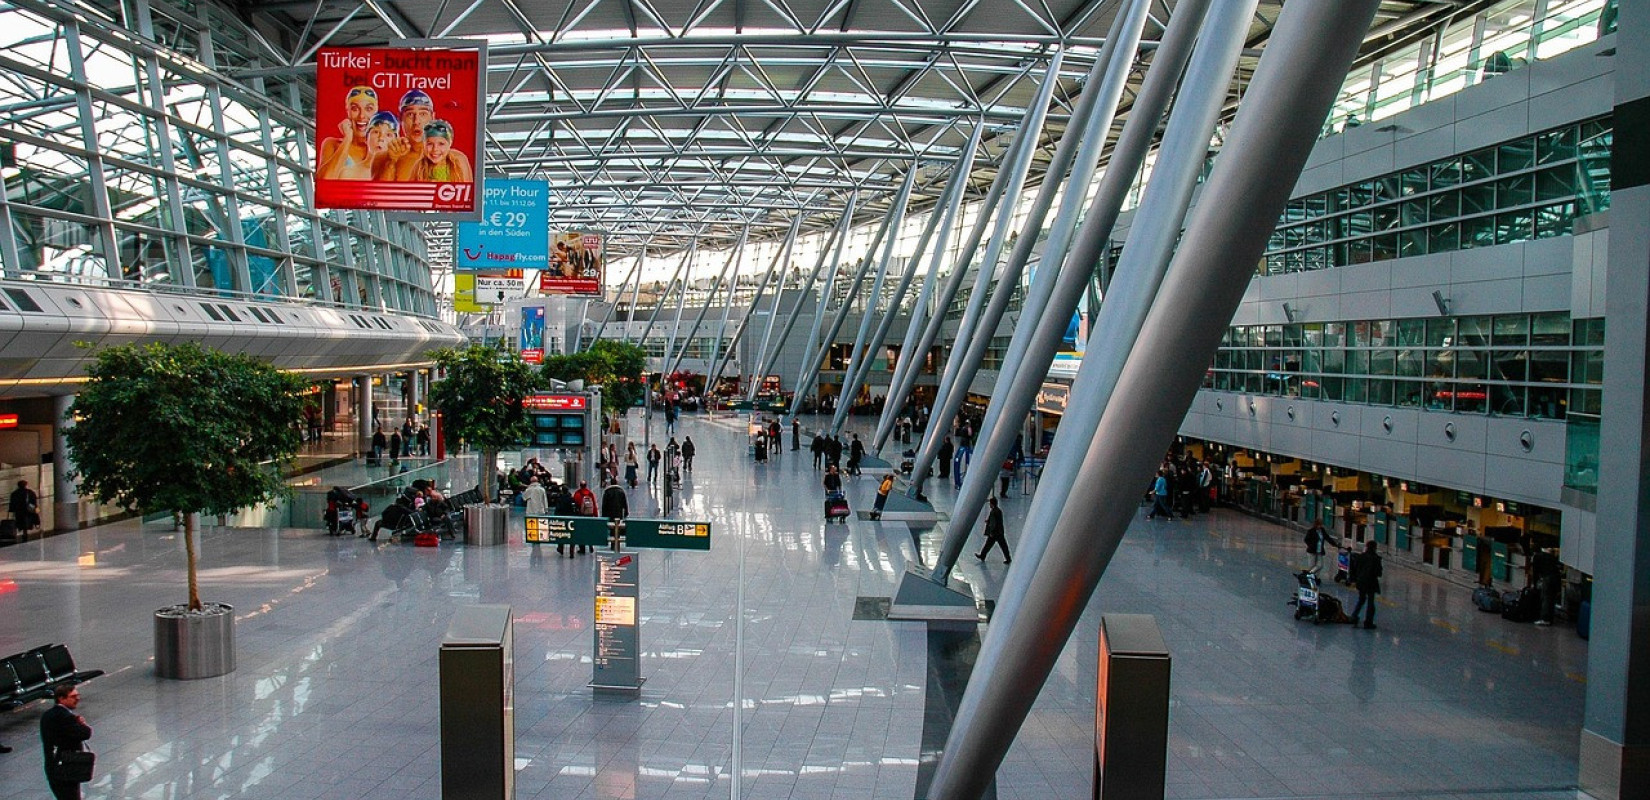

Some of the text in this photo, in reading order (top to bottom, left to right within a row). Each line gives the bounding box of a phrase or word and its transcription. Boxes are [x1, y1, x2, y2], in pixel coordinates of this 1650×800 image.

[321, 52, 371, 69] Türkei
[384, 54, 432, 70] bucht
[436, 58, 474, 70] man
[343, 71, 451, 90] bei GTI Travel
[438, 184, 471, 202] GTI
[511, 186, 539, 197] Hour
[490, 212, 502, 226] €
[487, 252, 546, 262] Hapagfly.com
[568, 520, 575, 531] C
[677, 524, 684, 534] B
